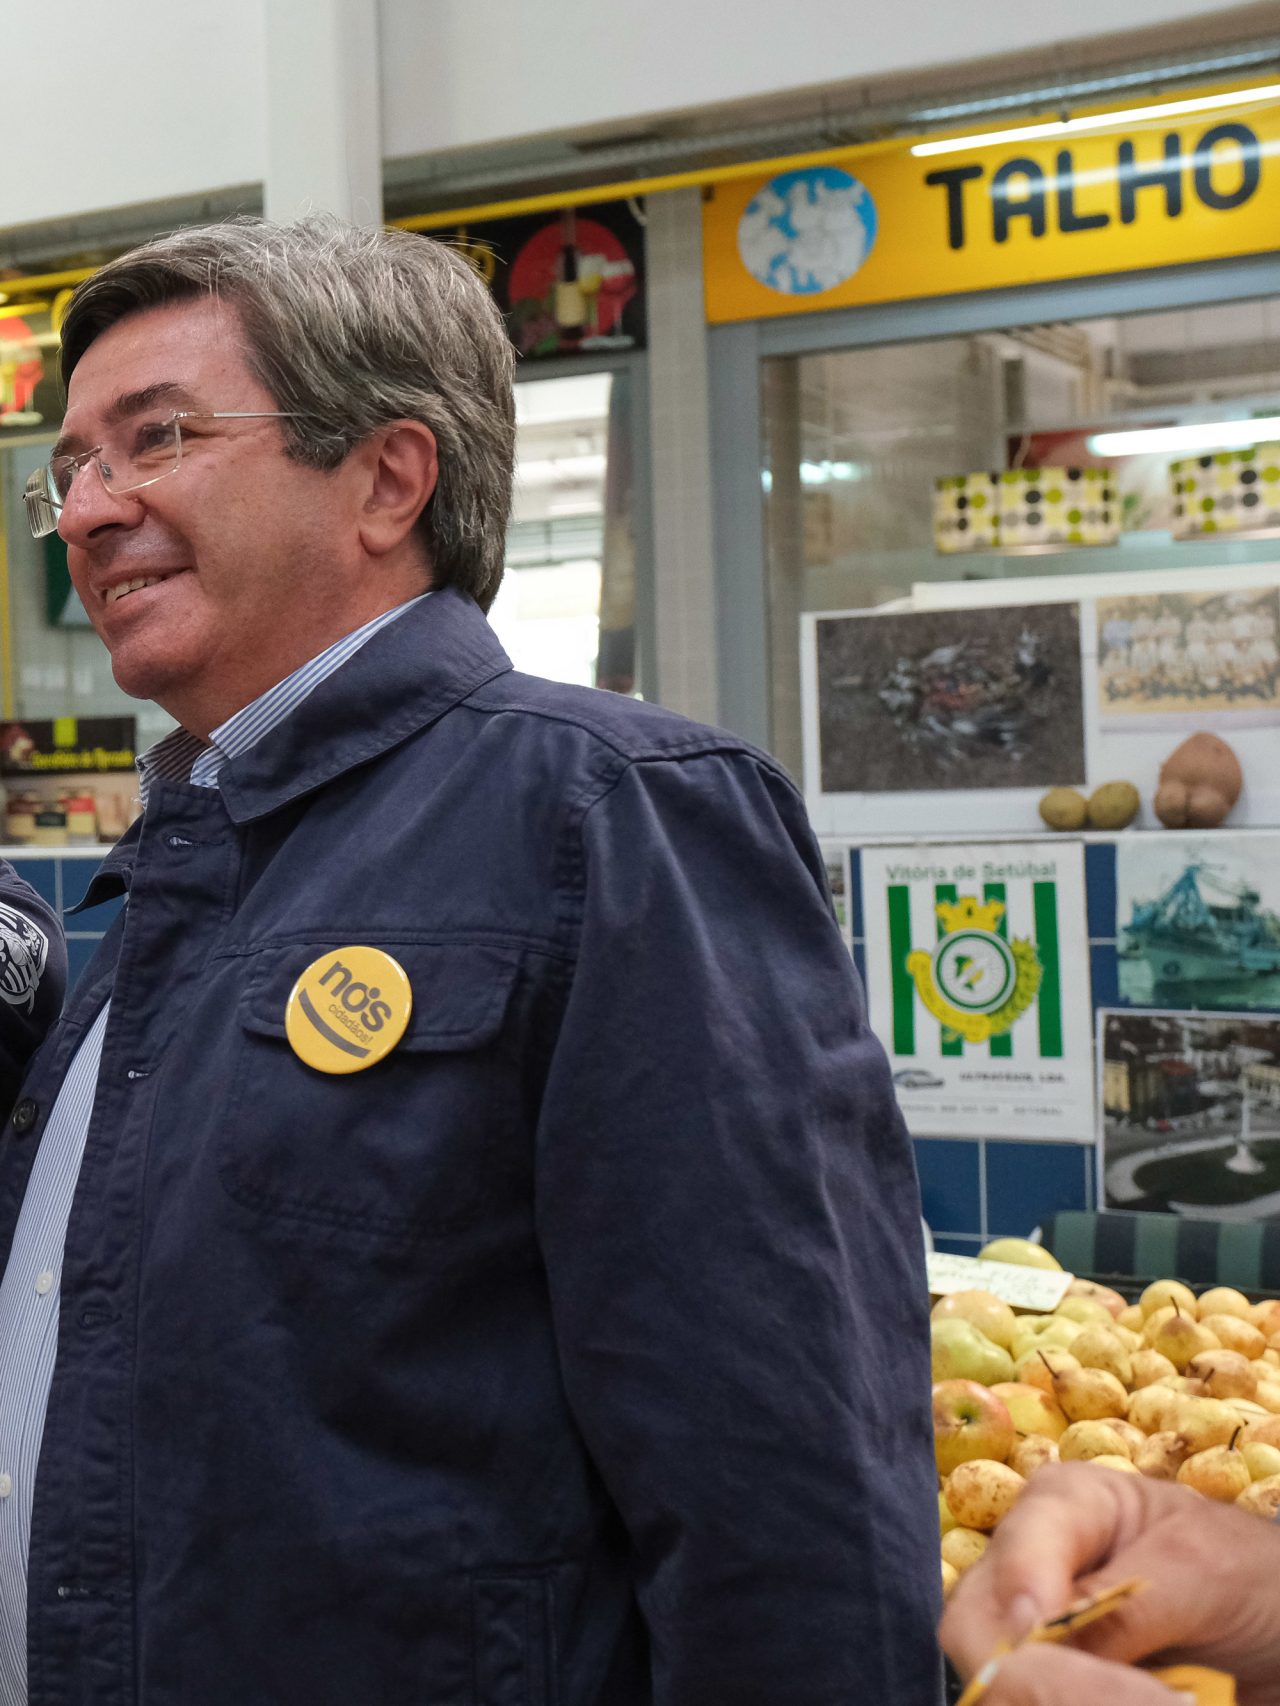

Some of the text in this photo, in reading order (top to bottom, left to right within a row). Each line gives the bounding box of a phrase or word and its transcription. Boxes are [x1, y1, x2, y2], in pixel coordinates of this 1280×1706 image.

[926, 123, 1261, 250] TALHO
[886, 861, 1057, 880] Vitória de Setúbal
